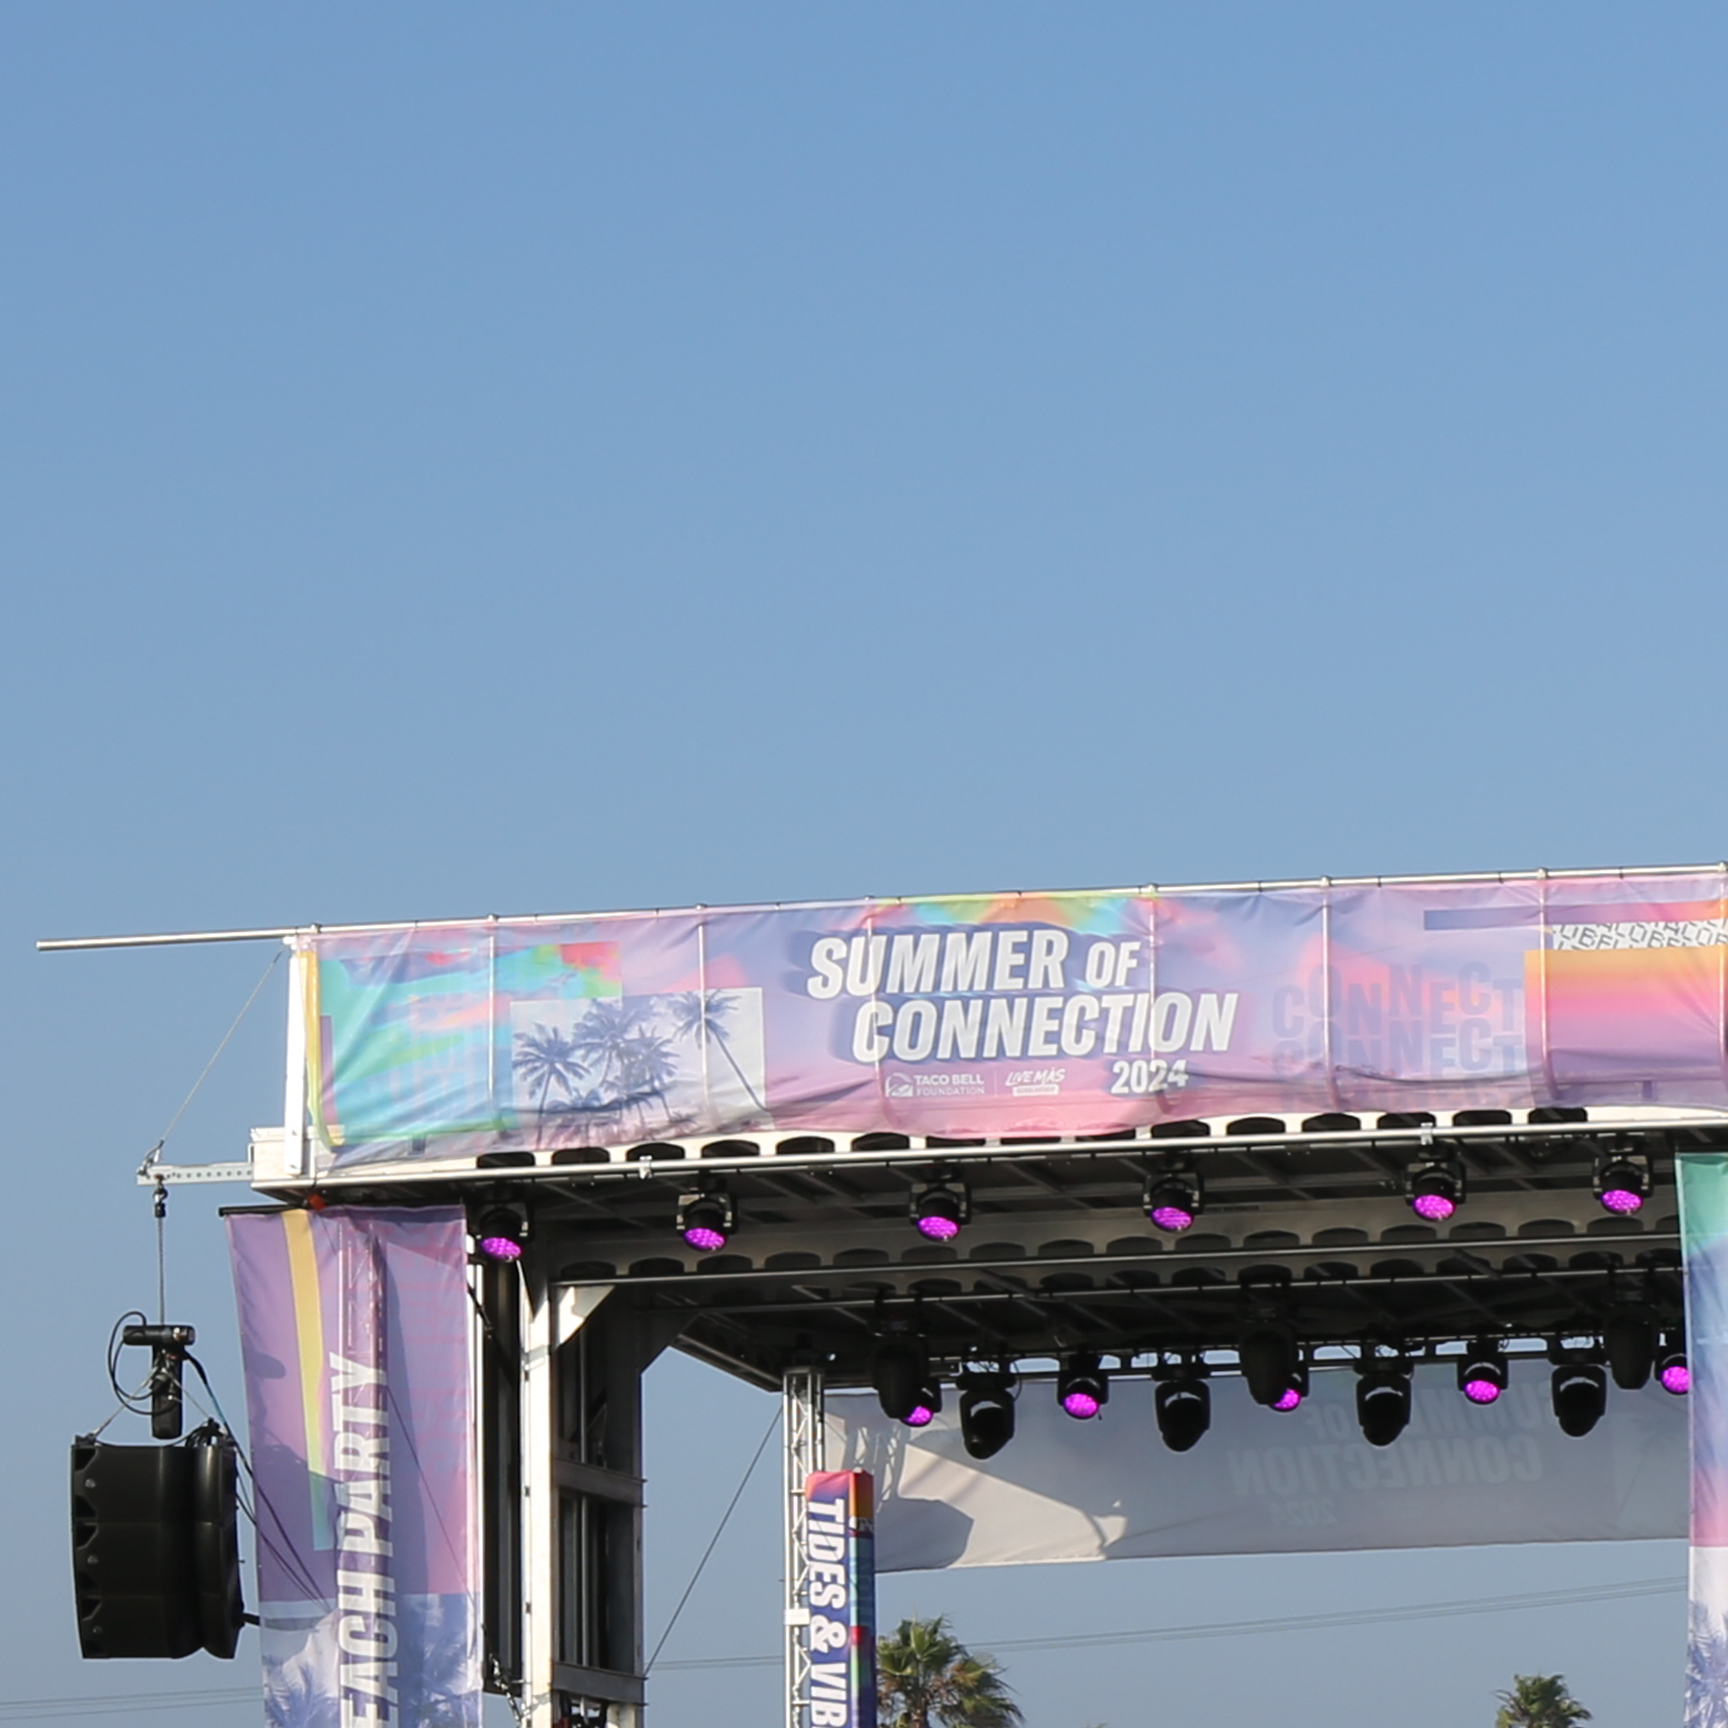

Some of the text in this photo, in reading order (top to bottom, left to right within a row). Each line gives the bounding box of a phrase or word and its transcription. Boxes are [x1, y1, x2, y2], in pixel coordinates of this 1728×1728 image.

[806, 929, 1141, 999] SUMMER OF
[852, 992, 1239, 1063] CONNECTION
[914, 1073, 985, 1086] TACO BELL
[916, 1086, 985, 1098] FOUNDATION
[1110, 1058, 1190, 1095] 2024
[329, 1351, 394, 1557] PARTY
[808, 1498, 848, 1609] TIDES
[810, 1613, 846, 1654] &
